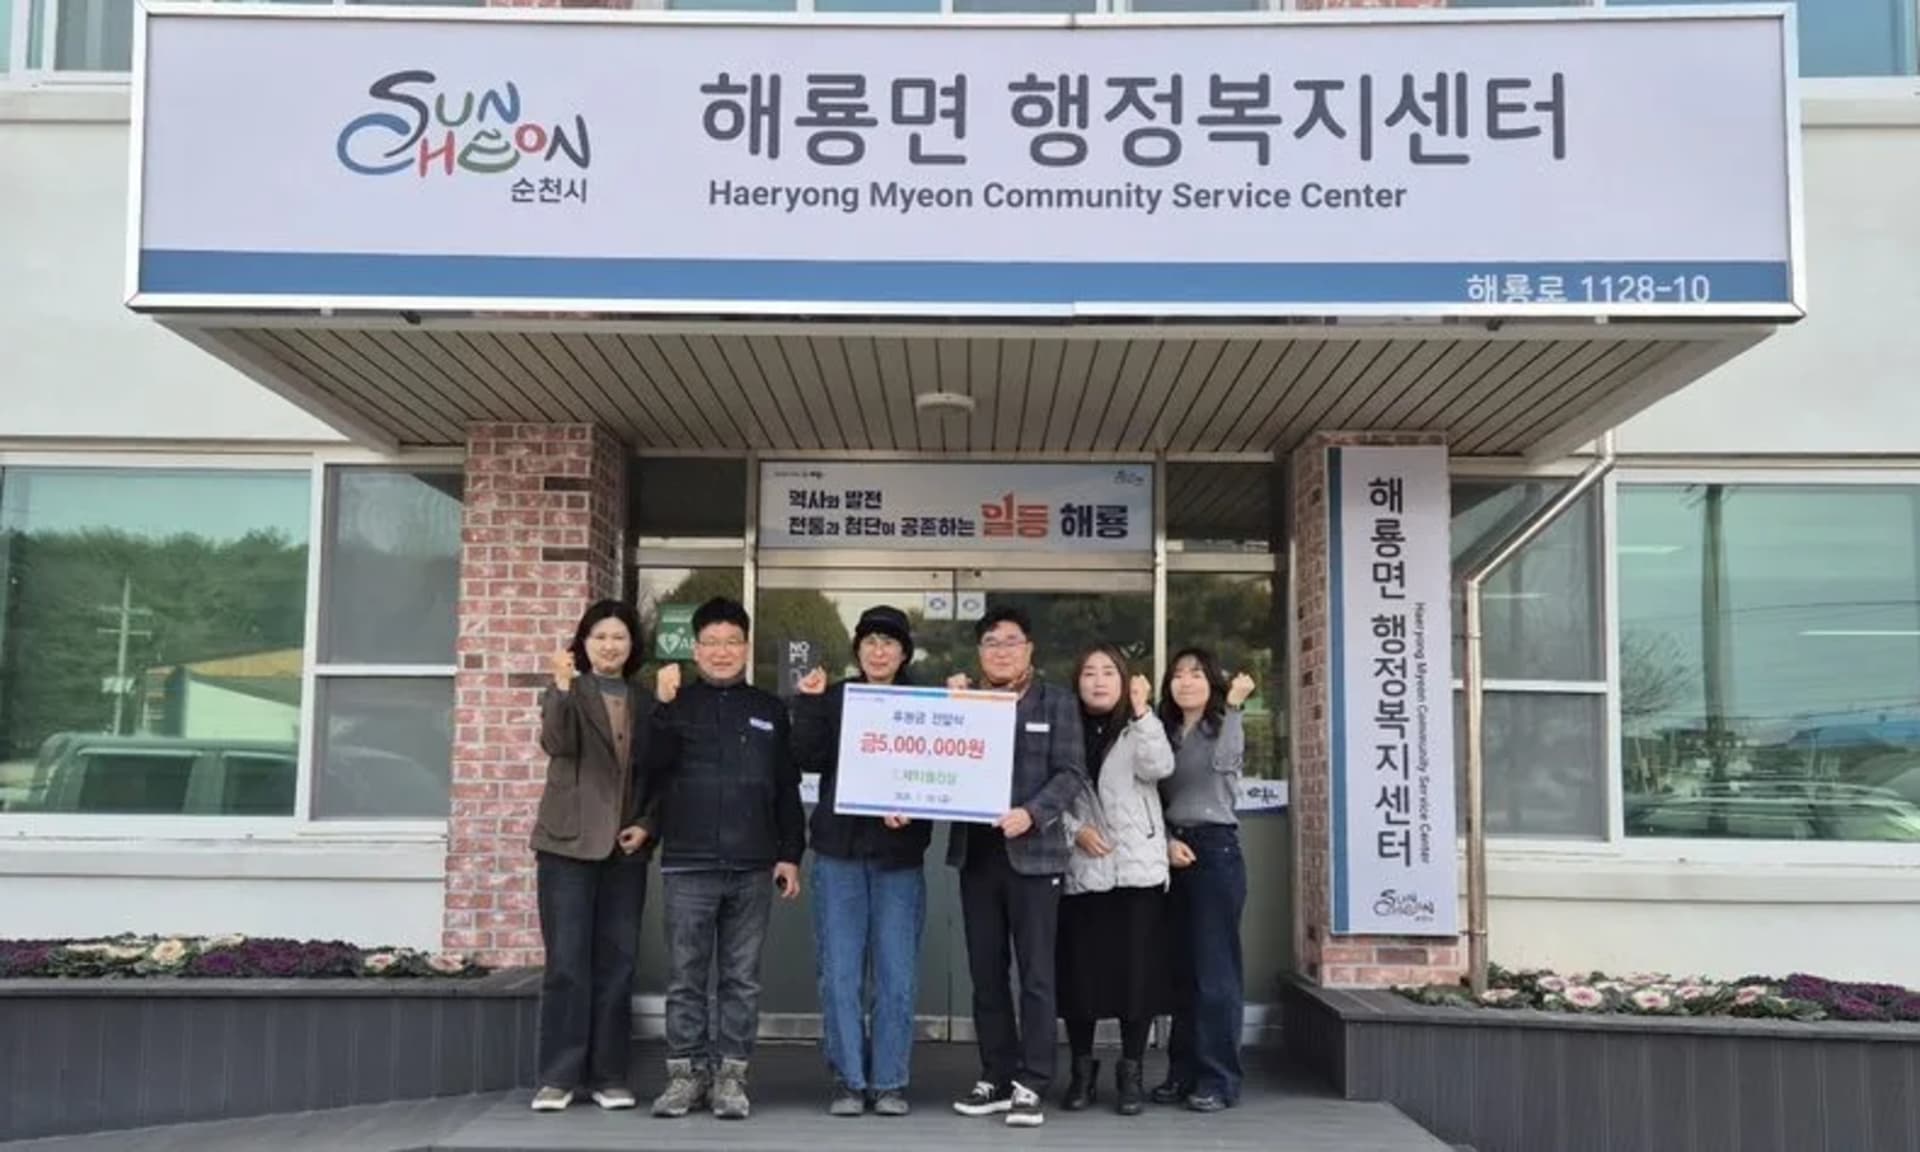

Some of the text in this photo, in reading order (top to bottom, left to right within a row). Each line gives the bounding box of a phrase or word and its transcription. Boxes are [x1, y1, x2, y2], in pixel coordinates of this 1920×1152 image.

[700, 71, 1566, 167] 해룡면 행정복지센터
[511, 176, 588, 203] 순천시
[709, 180, 1408, 215] Haeryong Myeon Community Service Center
[1467, 273, 1711, 303] 해룡로 1128-10
[844, 489, 883, 510] 발전
[900, 516, 975, 537] 공존하는
[981, 492, 1049, 538] 일등
[1059, 503, 1129, 539] 해룡
[1367, 477, 1412, 868] 해룡면 행정복지센터
